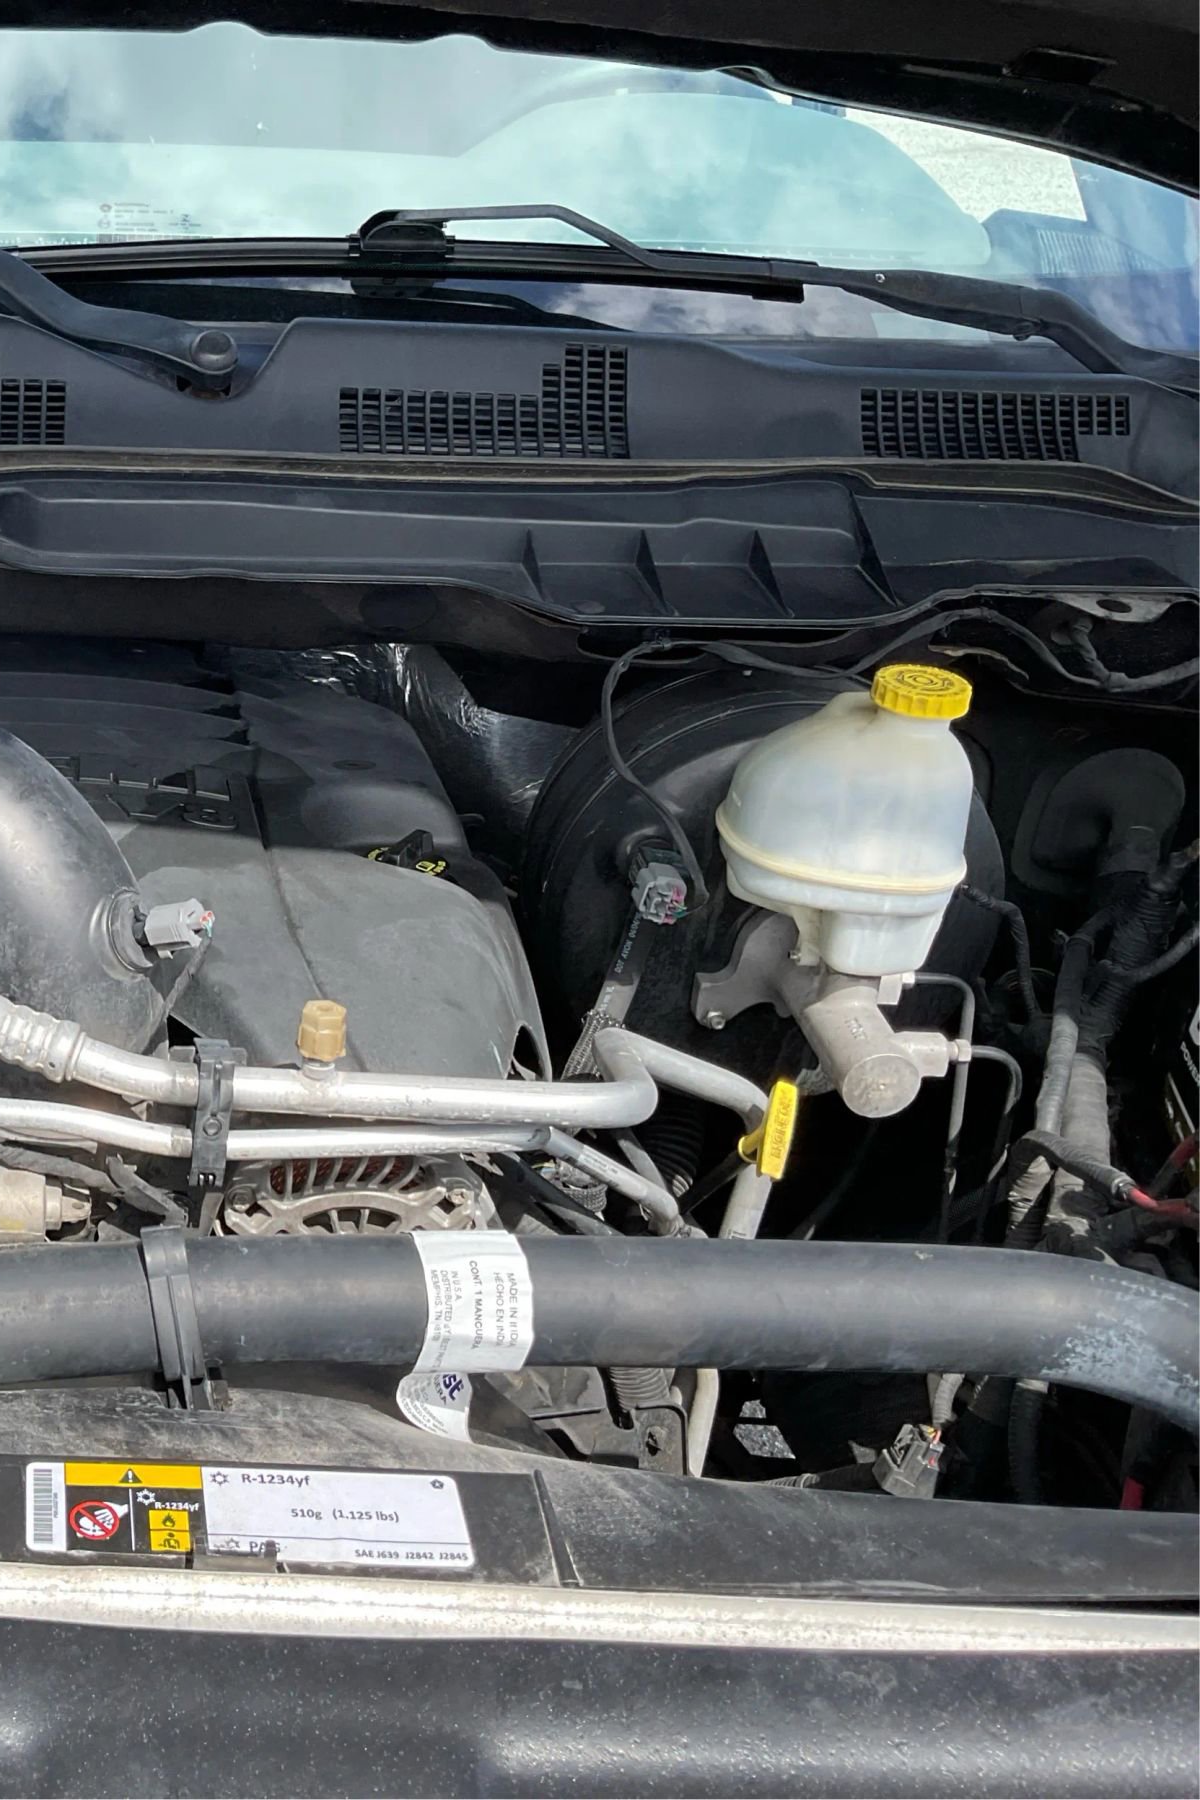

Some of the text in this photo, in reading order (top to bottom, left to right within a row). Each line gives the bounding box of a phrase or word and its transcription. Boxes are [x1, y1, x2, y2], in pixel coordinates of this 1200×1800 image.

[494, 1272, 505, 1306] HECHO
[507, 1272, 518, 1303] MADE
[496, 1309, 504, 1322] EN
[509, 1307, 518, 1318] IN
[470, 1298, 483, 1350] MANGUERA
[241, 1473, 311, 1488] R-1234yf
[154, 1501, 199, 1511] R-1234yf
[290, 1508, 400, 1523] 510g (1.125 lbs)
[355, 1549, 468, 1561] SAE J639 J2842 J2845
